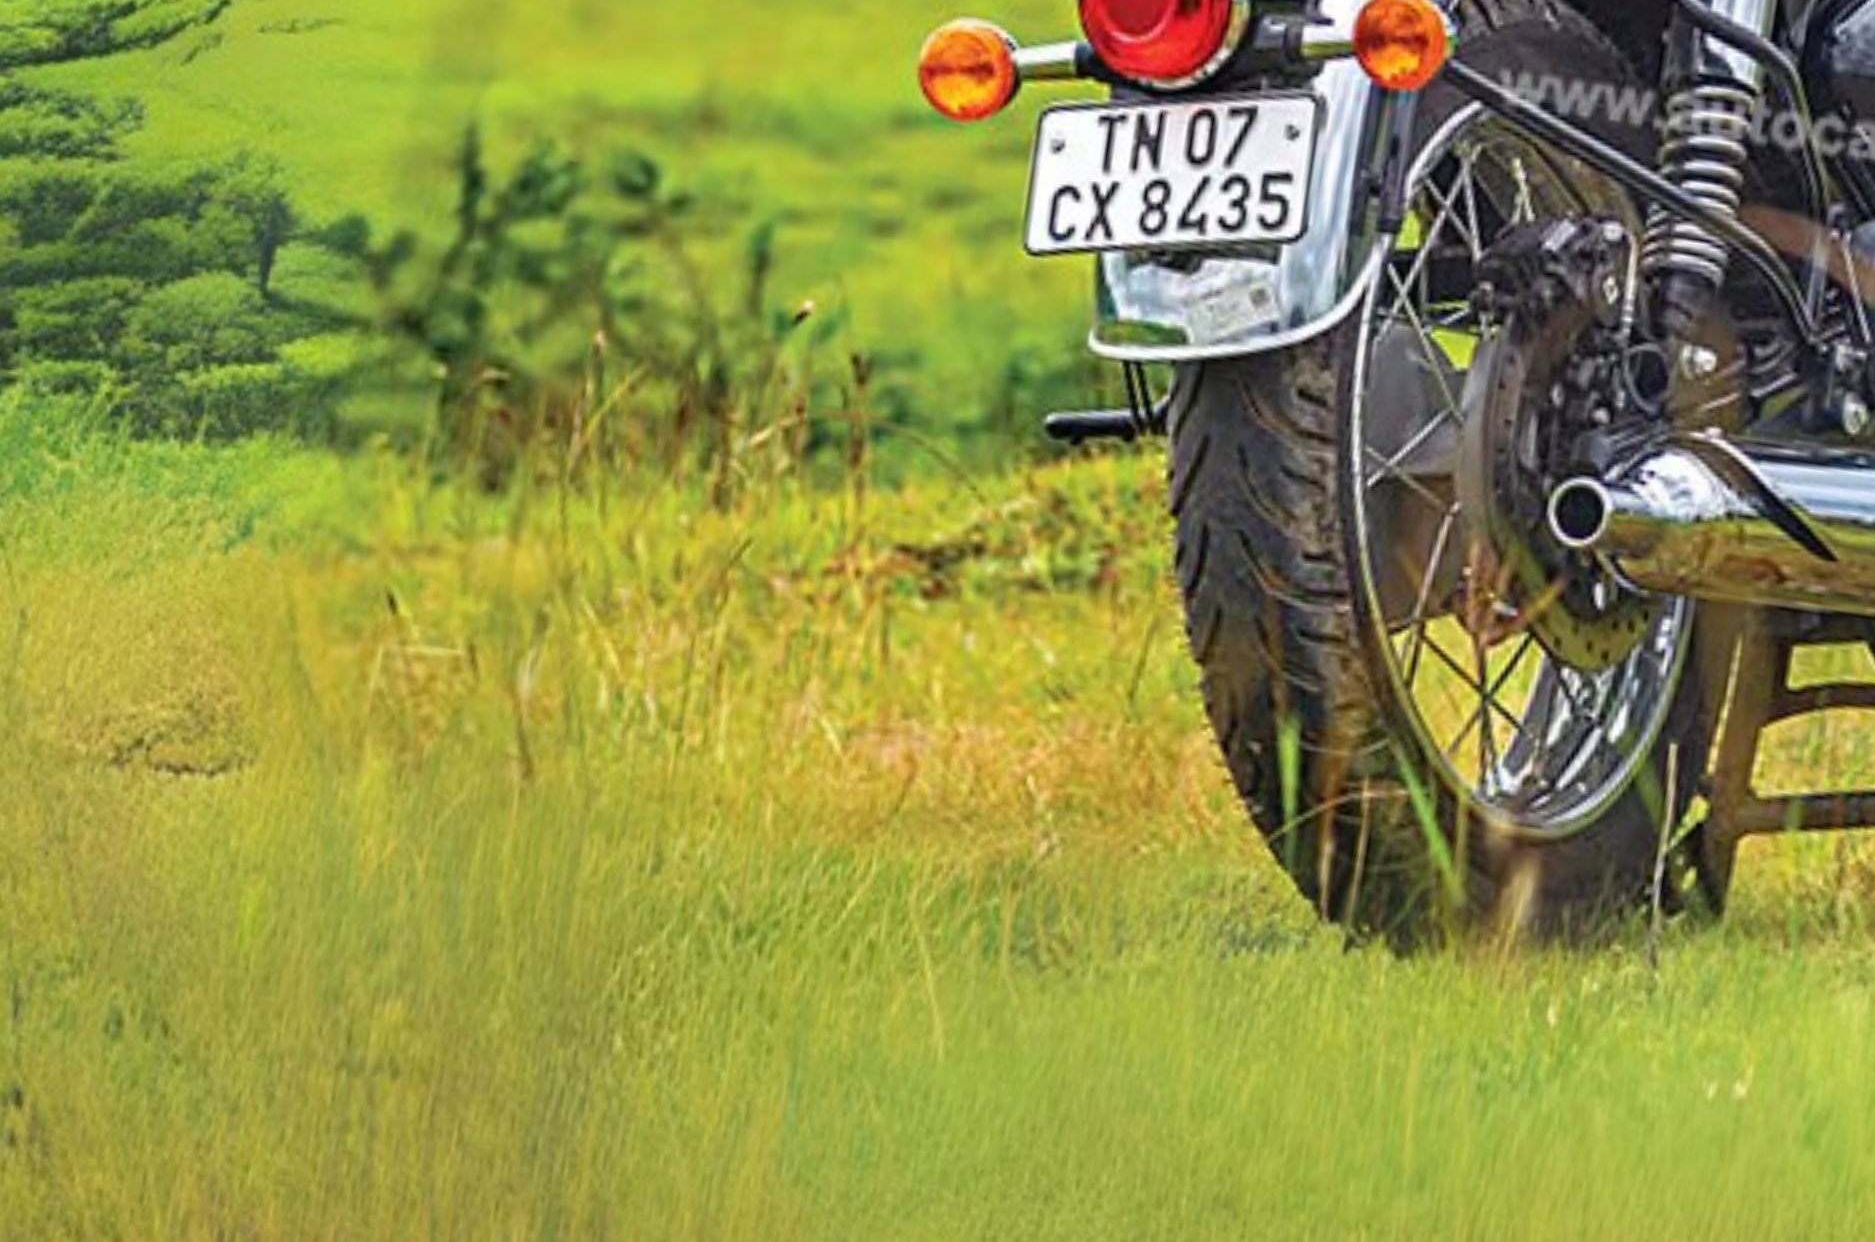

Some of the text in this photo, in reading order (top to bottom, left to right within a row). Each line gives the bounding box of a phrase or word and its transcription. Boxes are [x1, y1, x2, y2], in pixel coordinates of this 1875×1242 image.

[1098, 106, 1258, 174] TN 07
[1048, 171, 1293, 242] CX 8435
